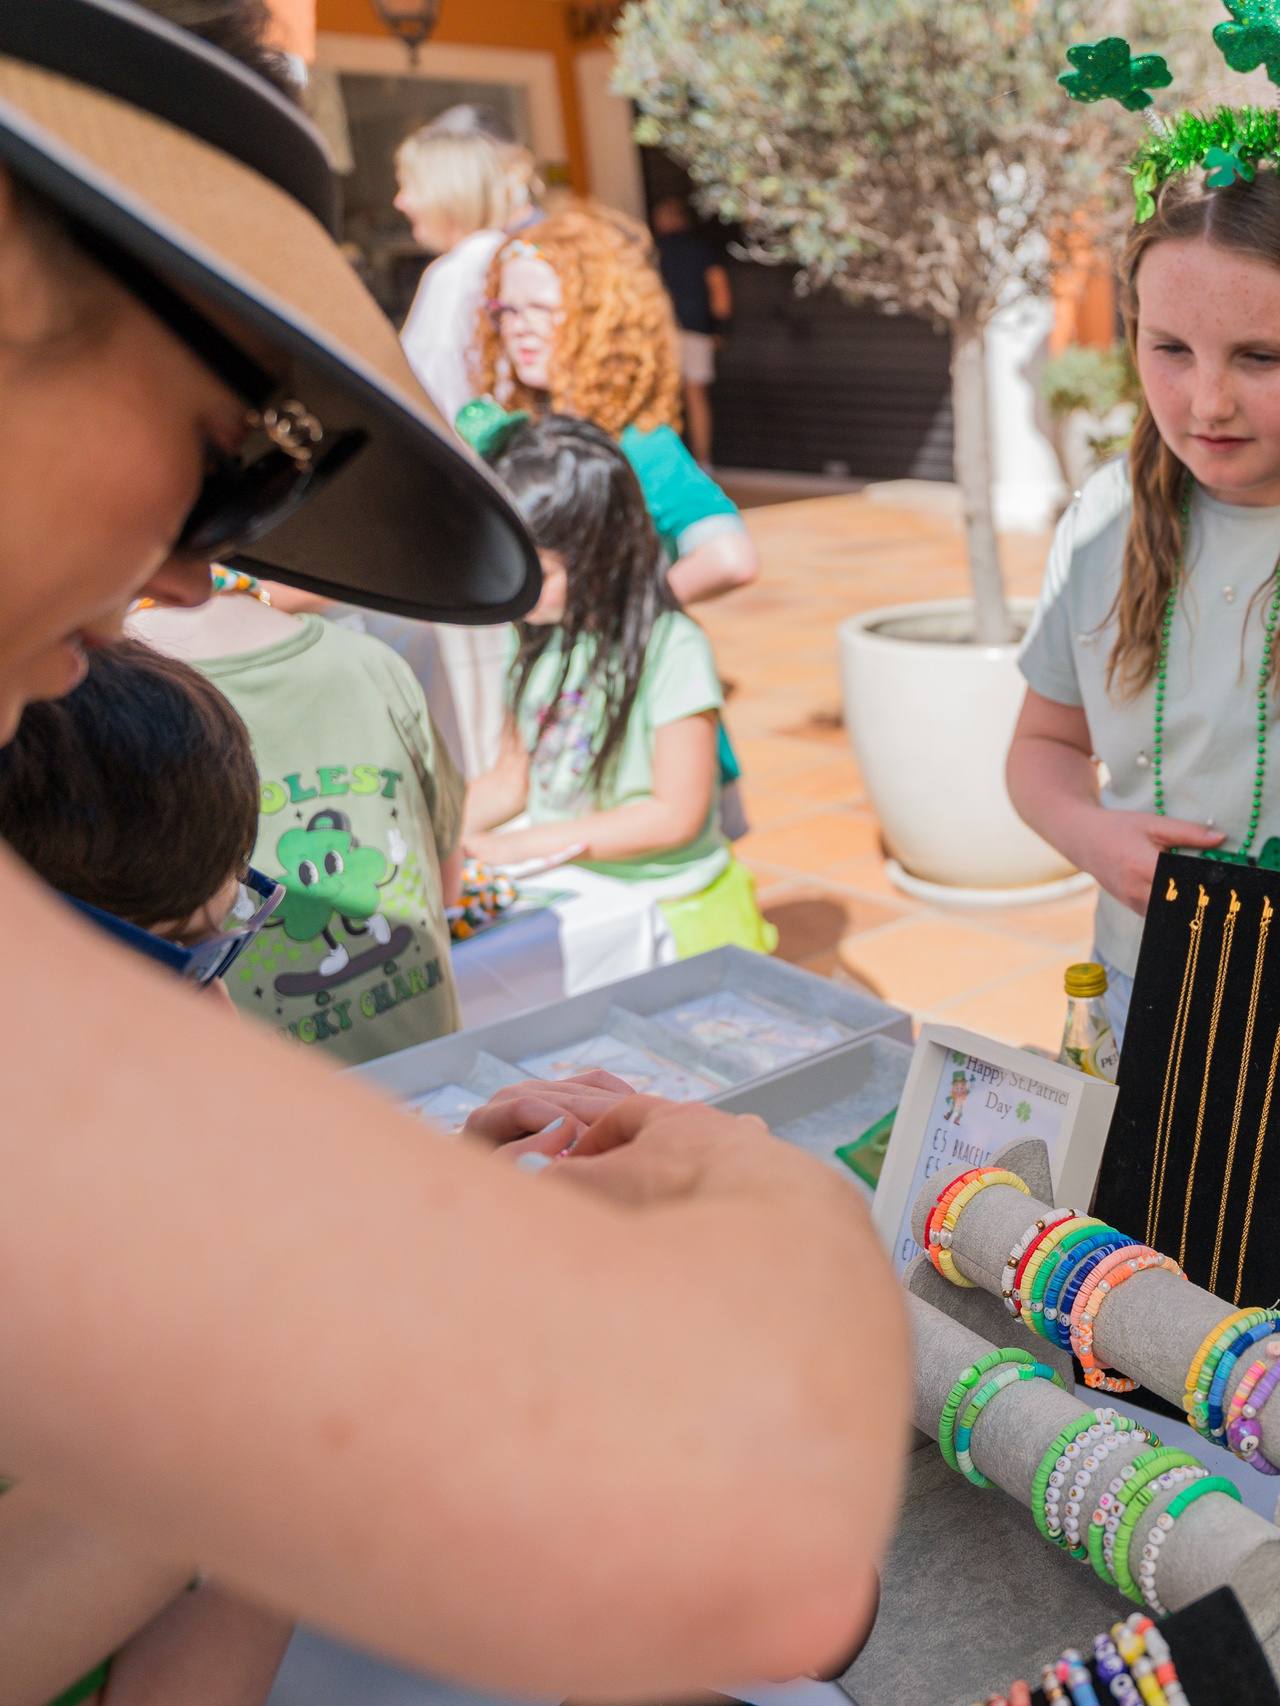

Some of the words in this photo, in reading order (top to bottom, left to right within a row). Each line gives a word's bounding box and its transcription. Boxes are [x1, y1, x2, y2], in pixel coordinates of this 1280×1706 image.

[286, 999, 352, 1044] CKY
[965, 1056, 1008, 1086] Happy
[1009, 1071, 1070, 1106] St.Patric
[985, 1091, 1012, 1119] Day
[933, 1128, 948, 1152] €5
